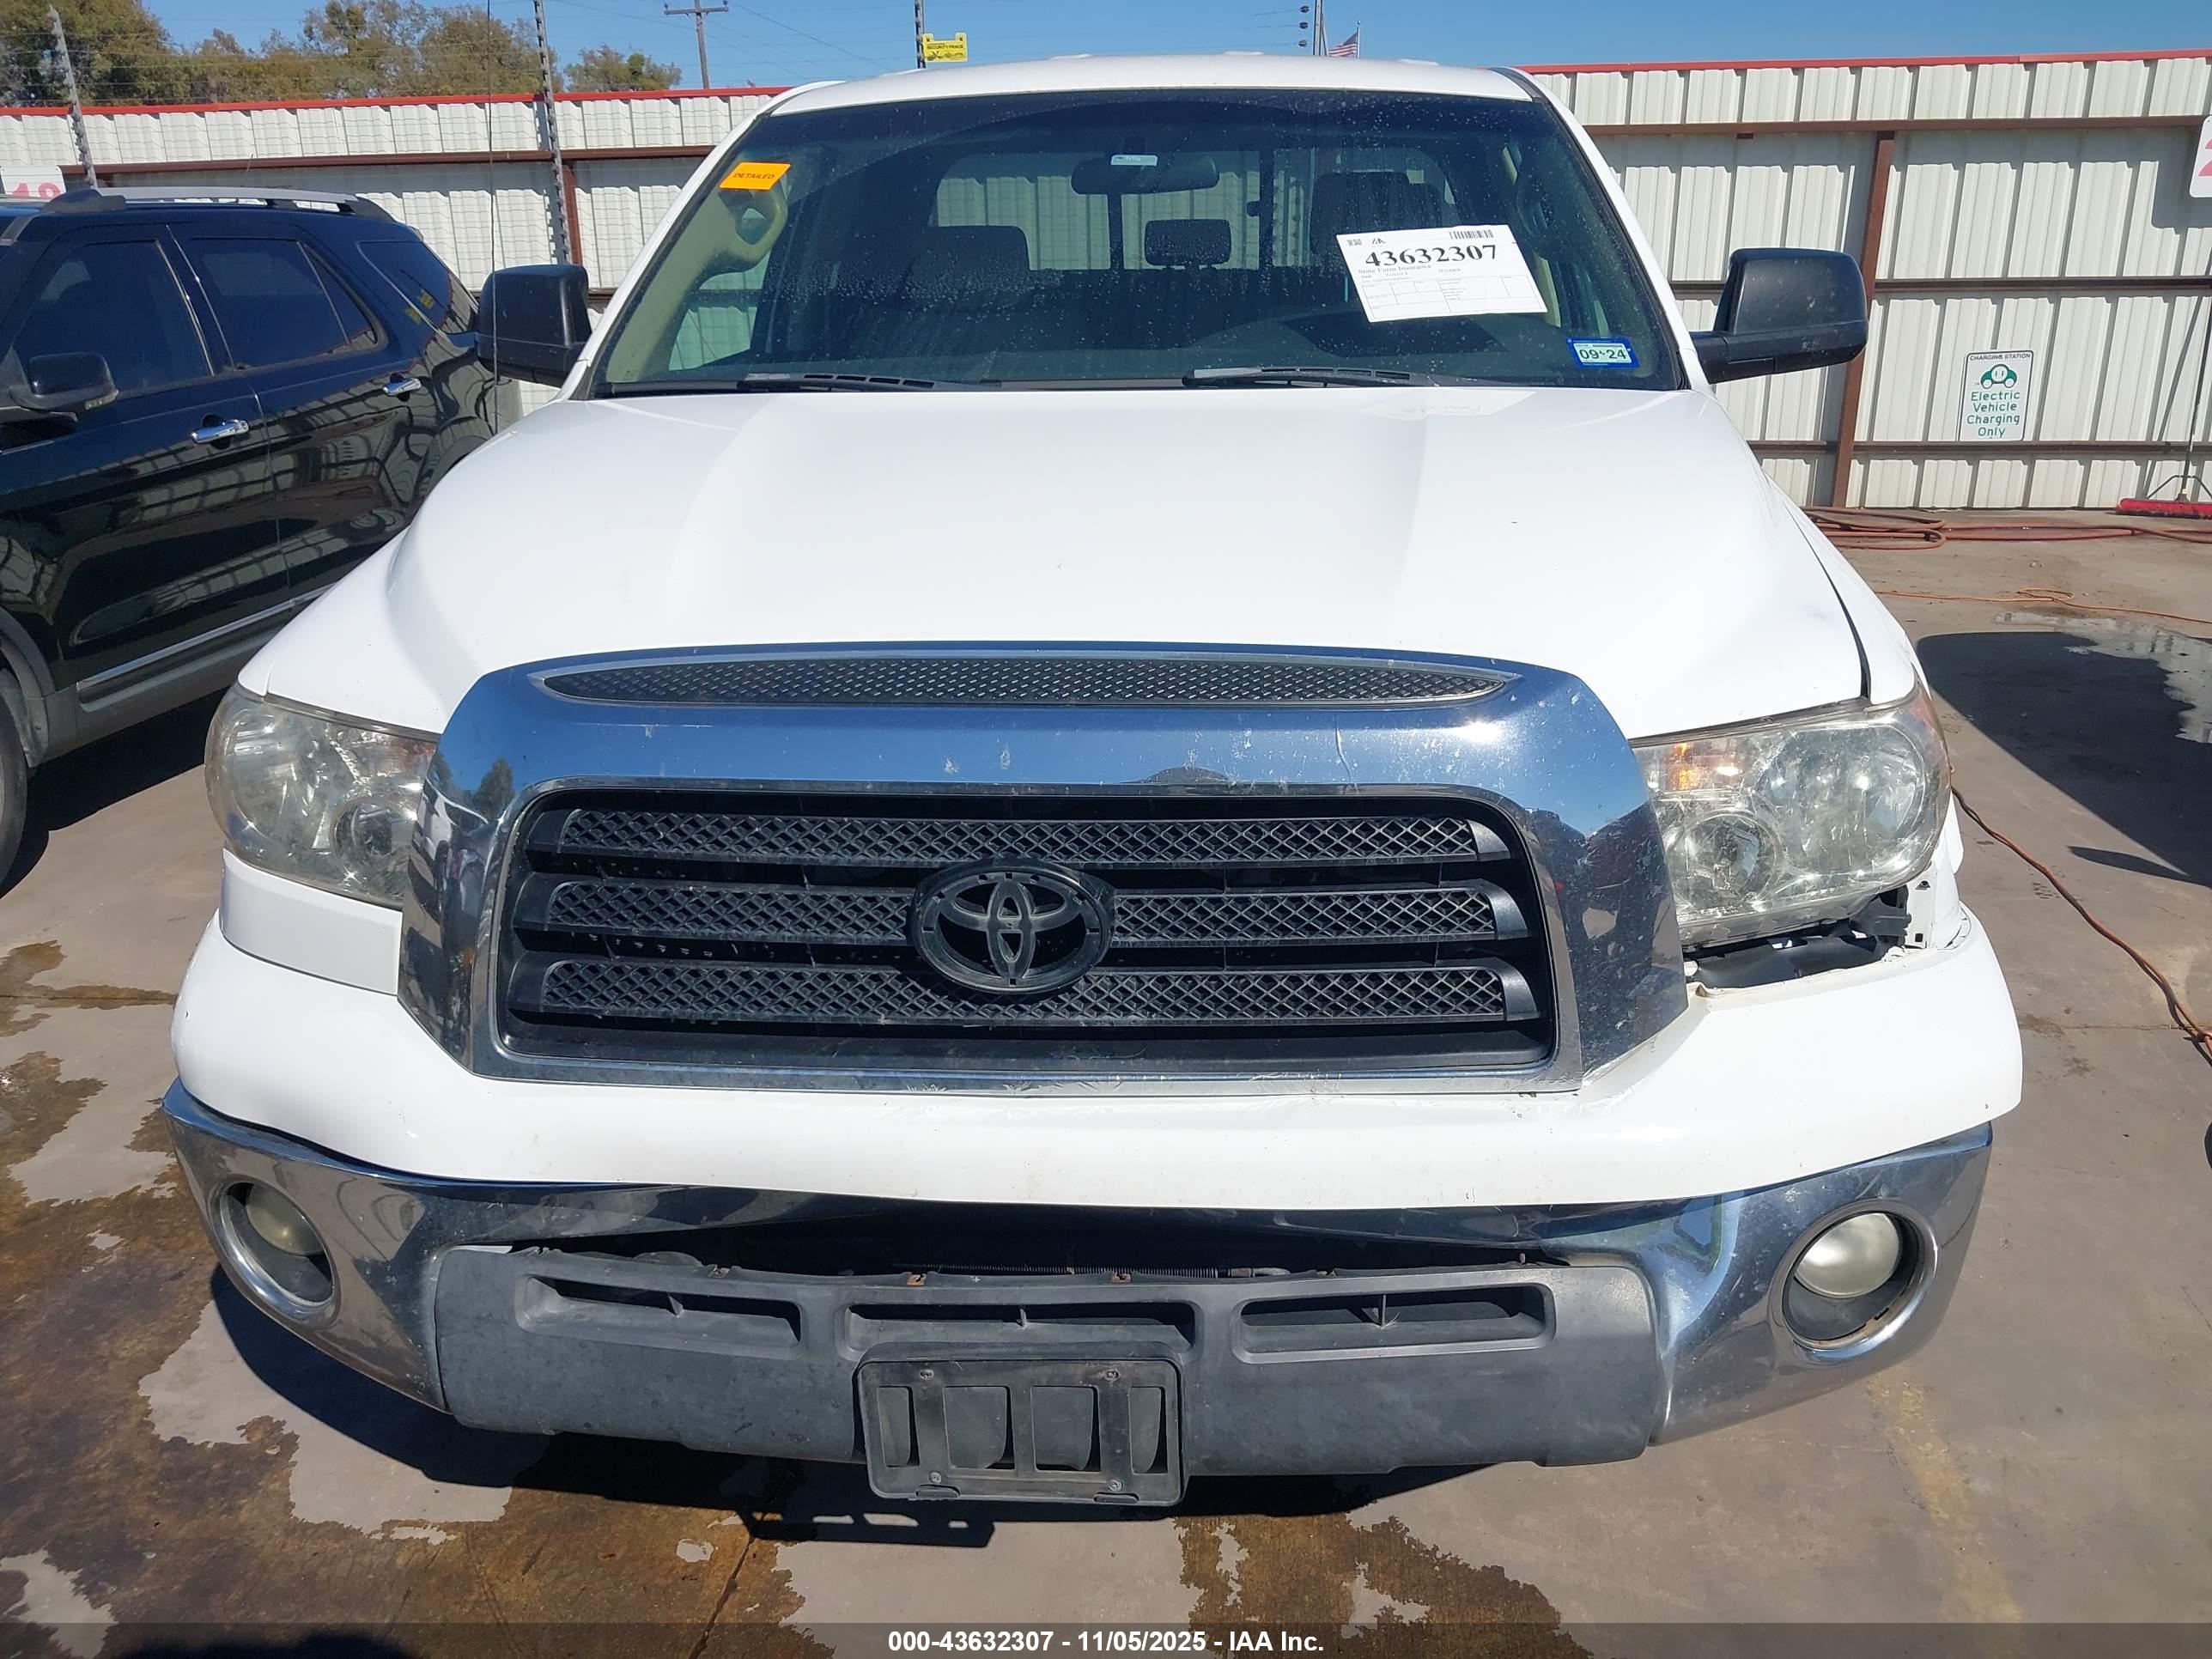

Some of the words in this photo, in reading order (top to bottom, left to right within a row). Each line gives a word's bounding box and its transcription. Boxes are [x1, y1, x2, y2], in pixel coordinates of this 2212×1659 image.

[1365, 244, 1496, 266] 43632307
[1971, 390, 2021, 401] Electric
[1973, 403, 2017, 412] Vehicle
[1966, 414, 2020, 426] Charging
[1978, 427, 2006, 438] Only
